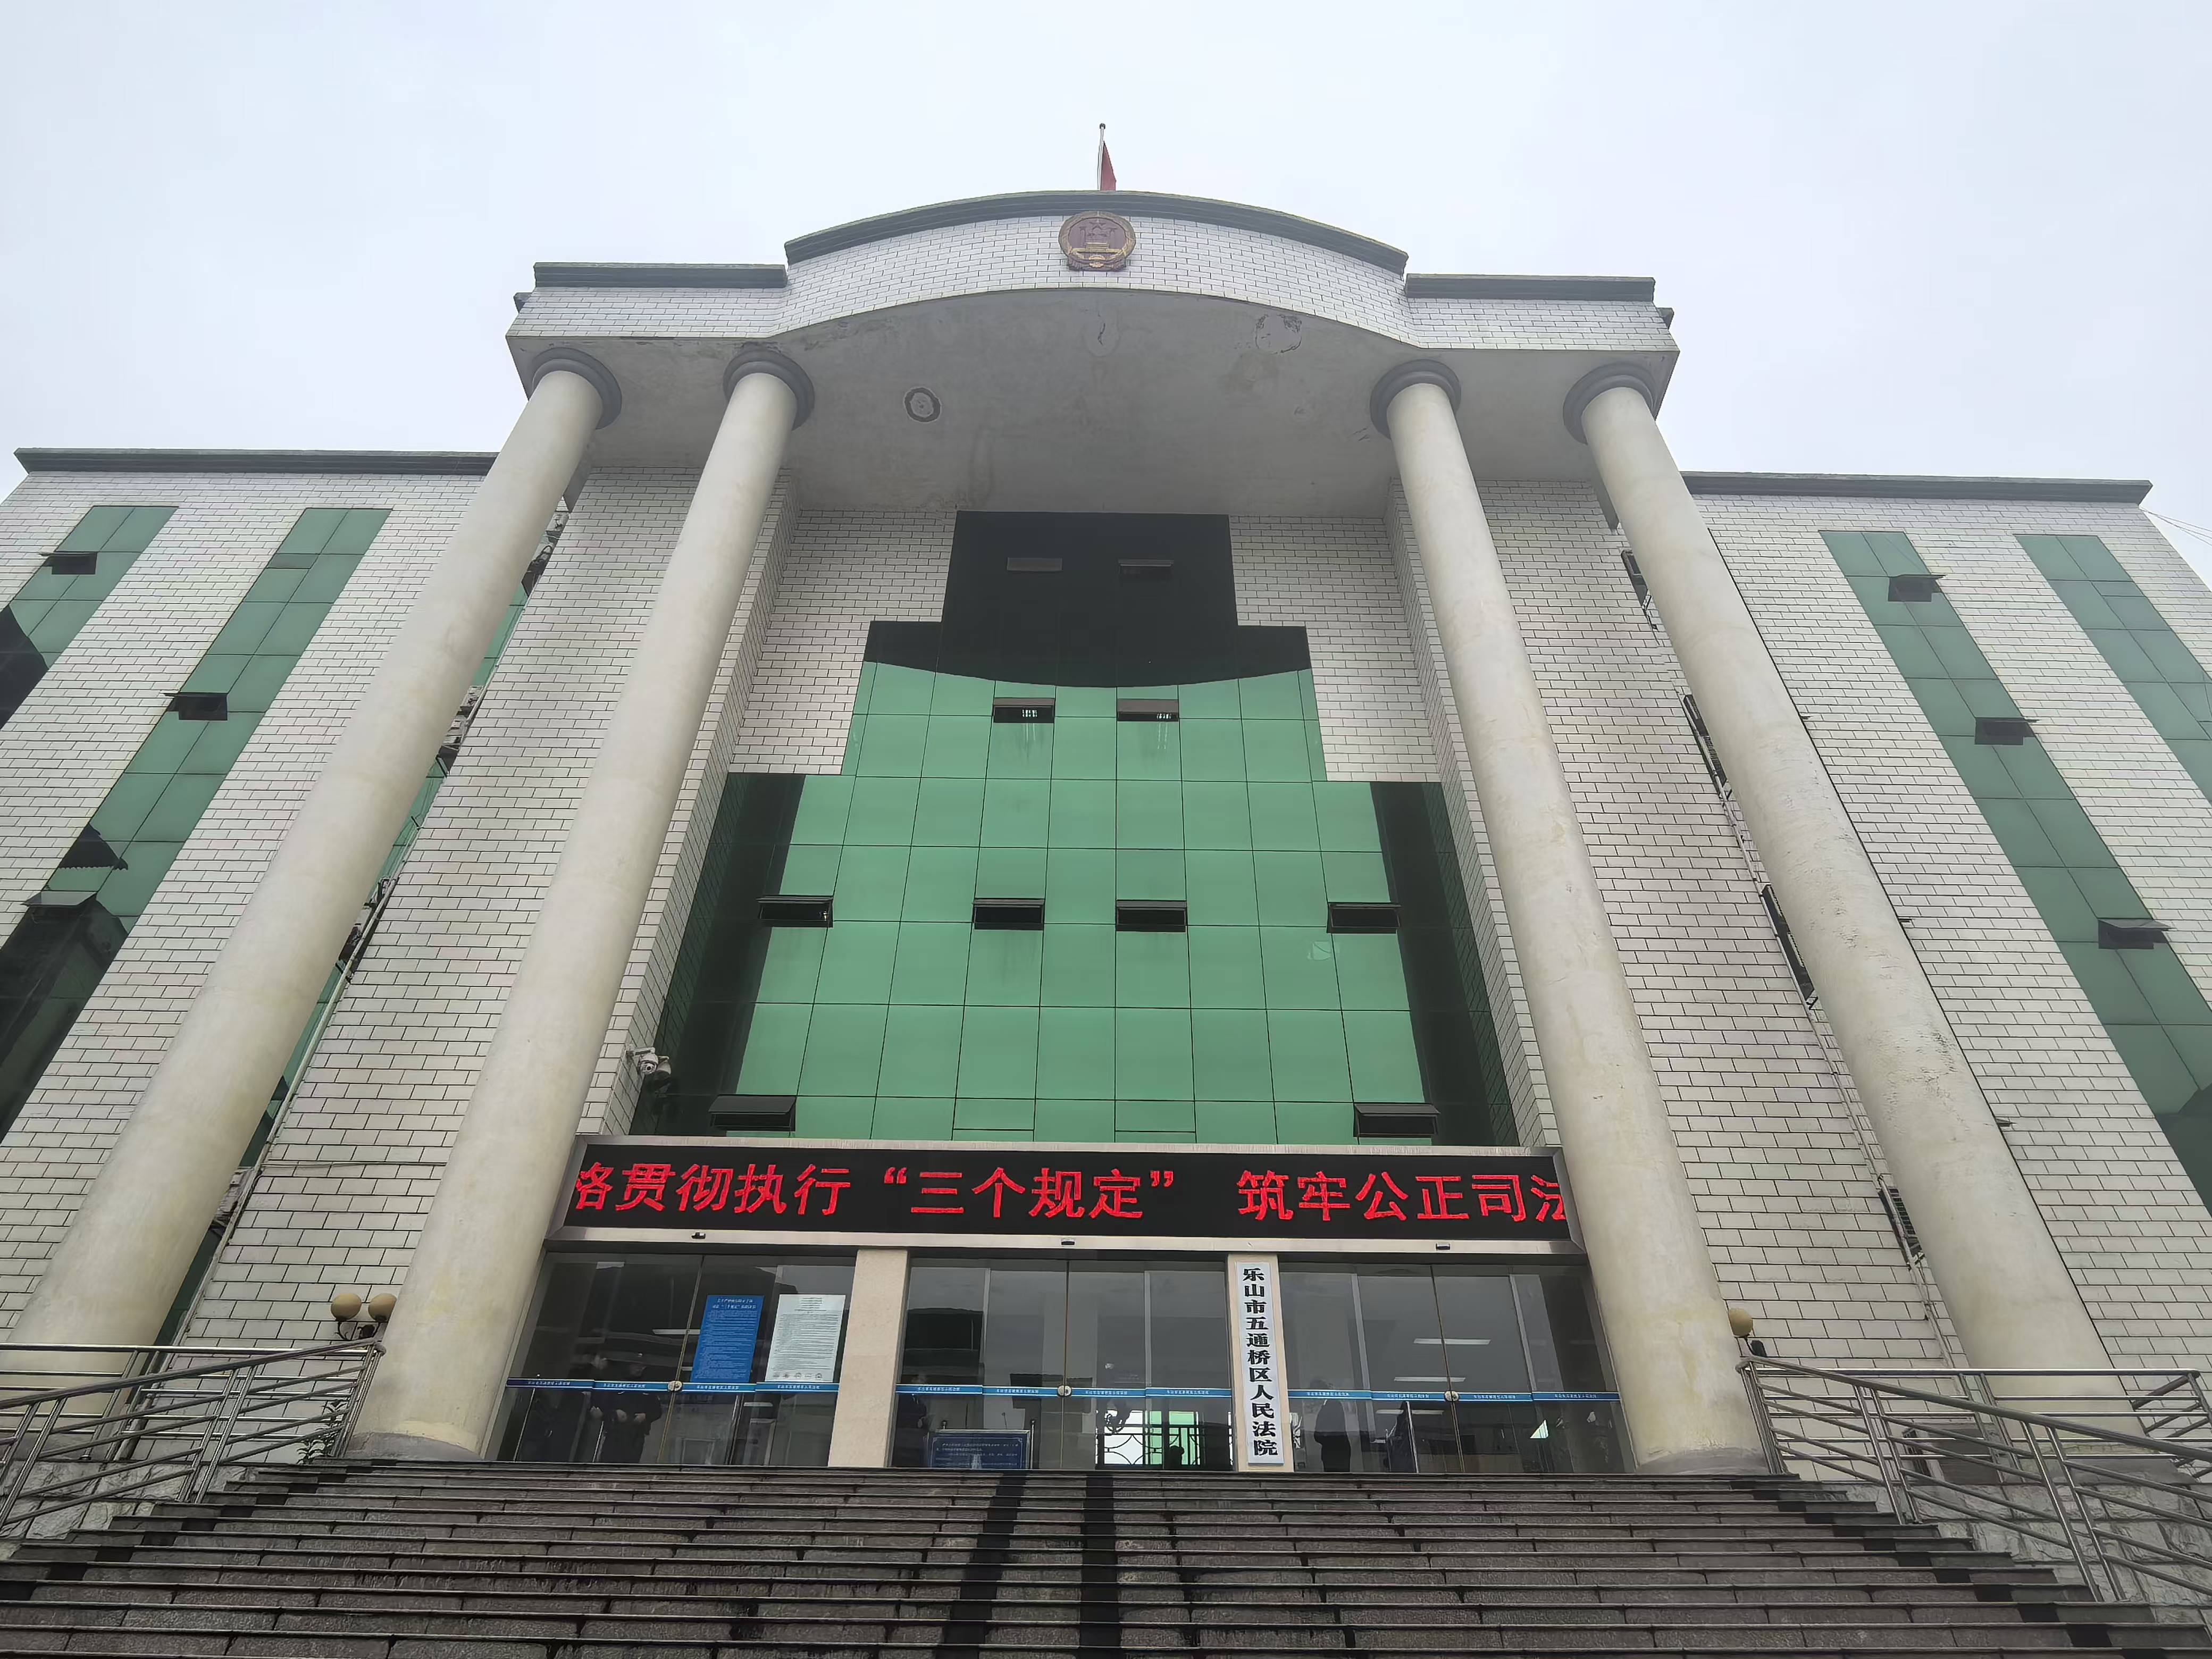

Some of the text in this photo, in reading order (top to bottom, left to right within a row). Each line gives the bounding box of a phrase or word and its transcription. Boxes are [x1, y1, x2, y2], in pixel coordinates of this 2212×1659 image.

[1243, 1268, 1278, 1456] 乐山市五通桥区人民法院
